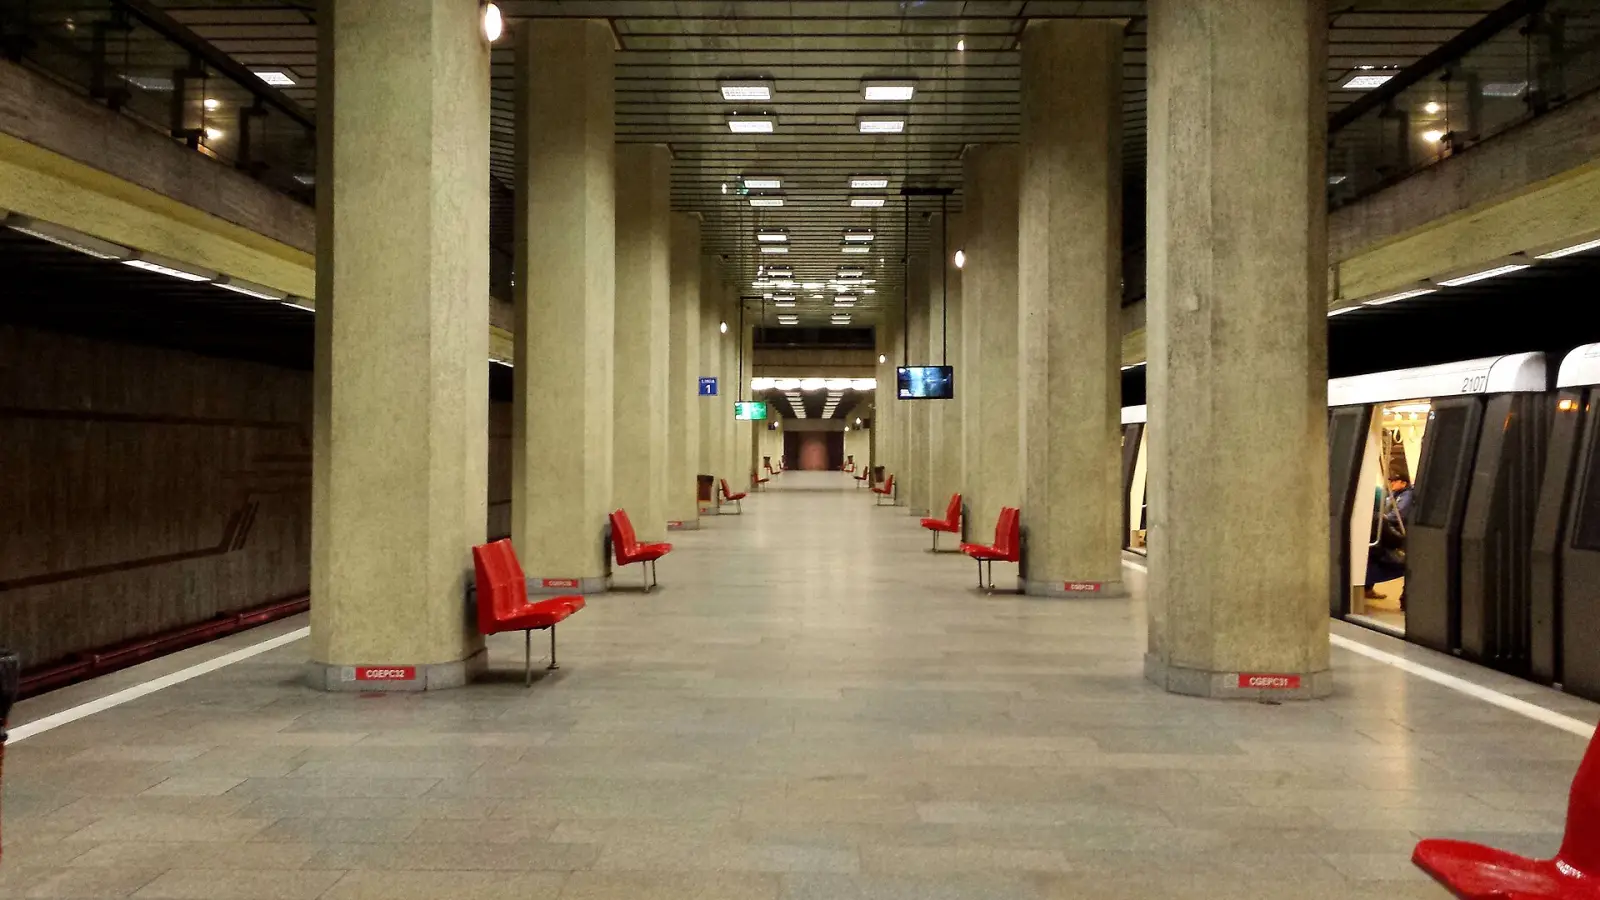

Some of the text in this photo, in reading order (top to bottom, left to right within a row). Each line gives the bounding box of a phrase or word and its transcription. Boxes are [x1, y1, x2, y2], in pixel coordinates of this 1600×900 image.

[1461, 375, 1486, 392] 2107
[705, 384, 711, 394] 1
[366, 669, 405, 678] CGEPC32
[1249, 677, 1289, 686] CGEPC31
